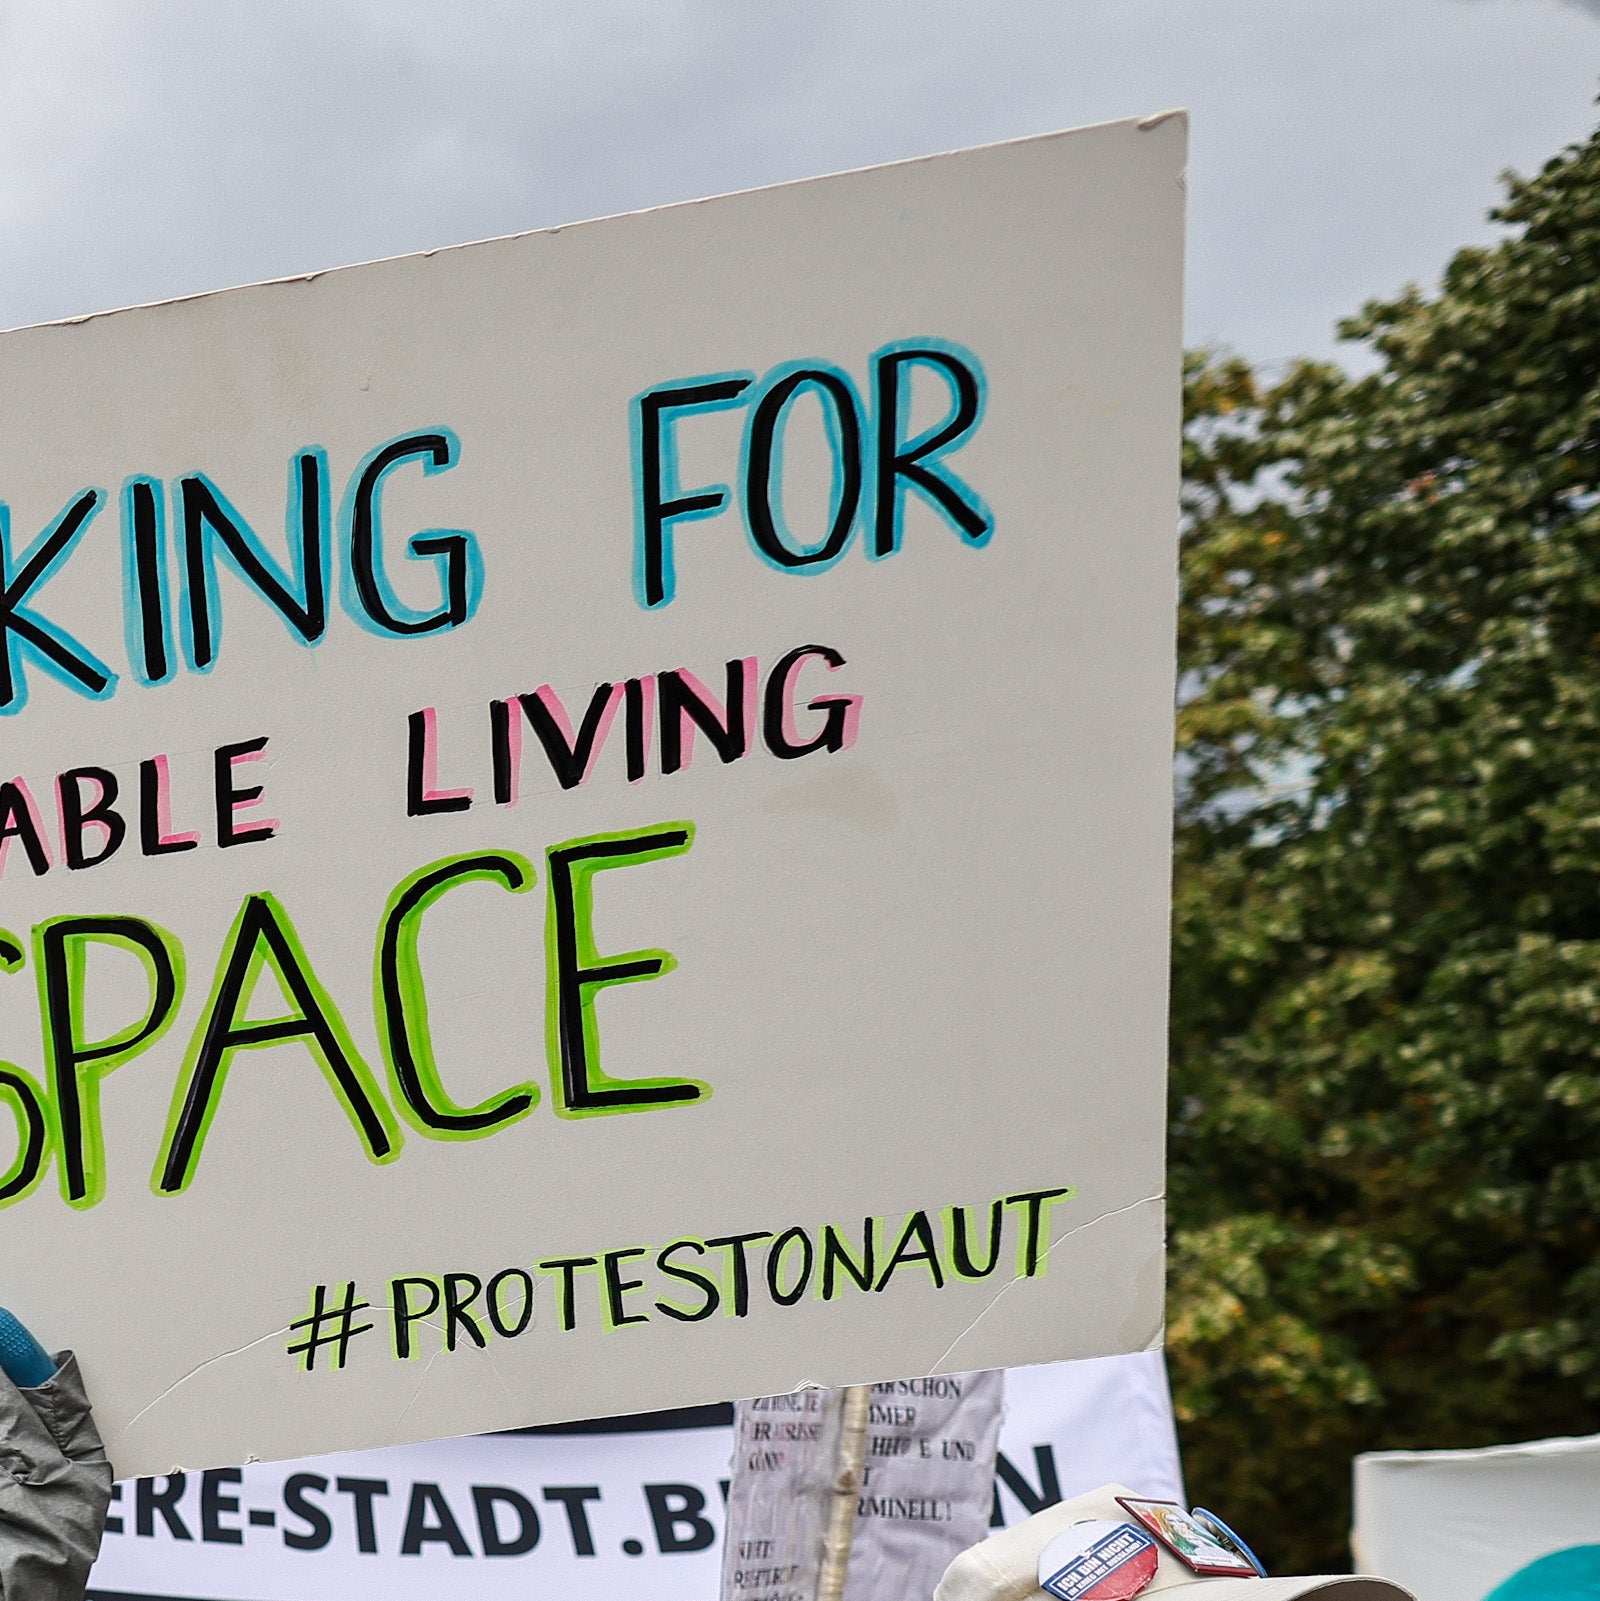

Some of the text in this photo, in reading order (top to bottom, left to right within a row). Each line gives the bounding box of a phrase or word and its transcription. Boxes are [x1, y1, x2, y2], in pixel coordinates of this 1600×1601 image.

[629, 337, 995, 610] FOR
[405, 645, 863, 817] LIVING
[286, 1187, 1077, 1370] #PROTESTONAUT
[1056, 1532, 1135, 1592] ICH BIN NICHT
